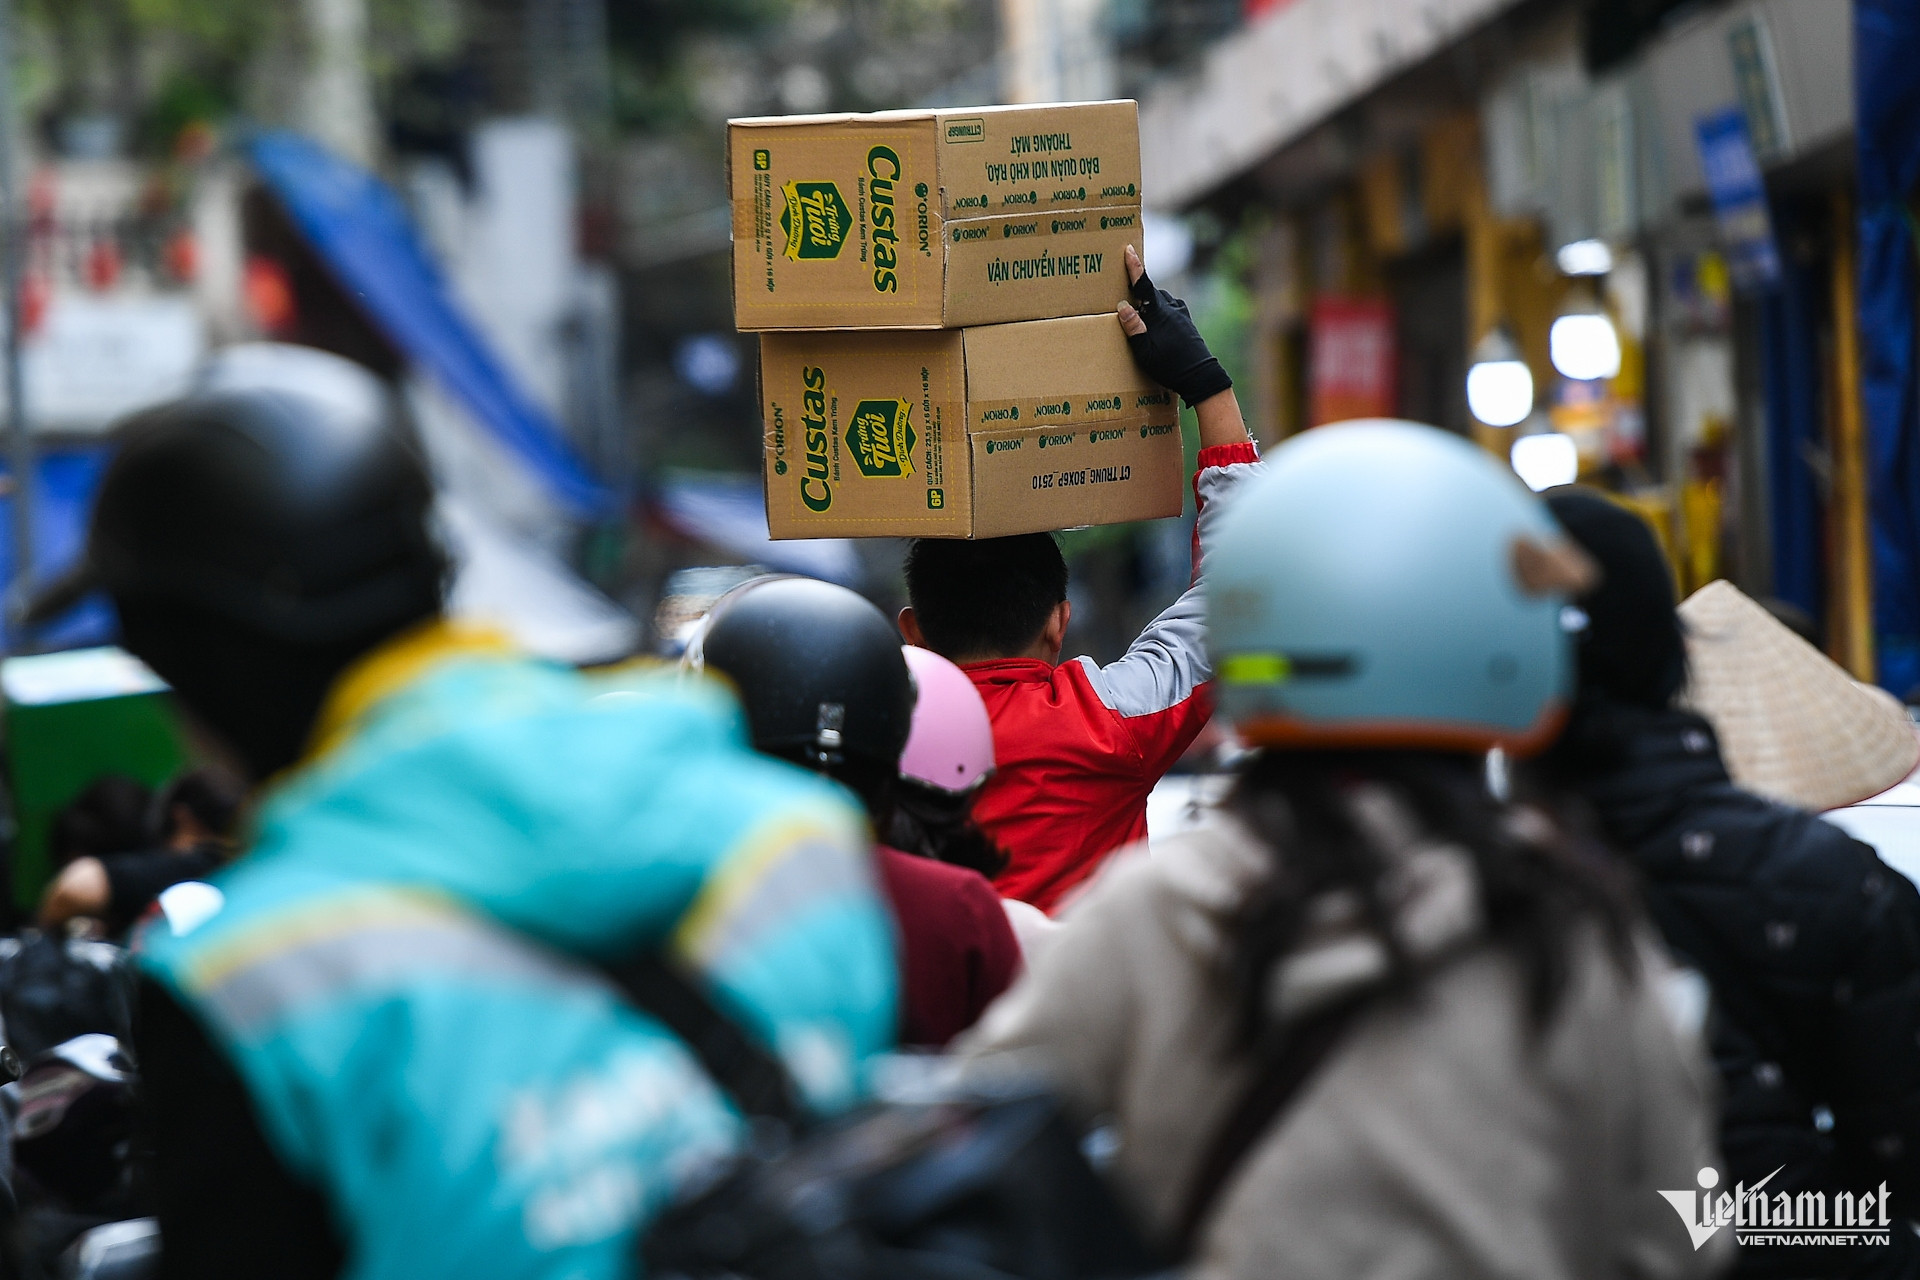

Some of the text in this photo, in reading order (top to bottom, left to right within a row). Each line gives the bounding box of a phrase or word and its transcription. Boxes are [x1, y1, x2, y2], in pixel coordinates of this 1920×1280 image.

[1010, 132, 1072, 157] THOÁNG MÁT
[755, 152, 767, 169] 6P
[985, 156, 1100, 185] BẢO QUẢN NƠI KHÔ RÁO,
[956, 185, 1125, 209] ORION ORION ORION ORION
[859, 197, 867, 222] Custas
[866, 144, 902, 294] Custas
[917, 202, 929, 252] ORION
[962, 216, 1133, 240] ORION ORION ORION ORION
[987, 249, 1103, 286] VẬN CHUYỂN NHẸ TAY
[984, 408, 1008, 421] ORION
[1036, 403, 1060, 416] ORION
[1087, 398, 1112, 411] ORION
[772, 406, 786, 456] ORION
[800, 365, 833, 513] Custas
[996, 439, 1022, 451] ORION
[1048, 434, 1073, 446] ORION
[1099, 429, 1124, 441] ORION
[1118, 465, 1131, 481] CT
[931, 490, 942, 507] 6P
